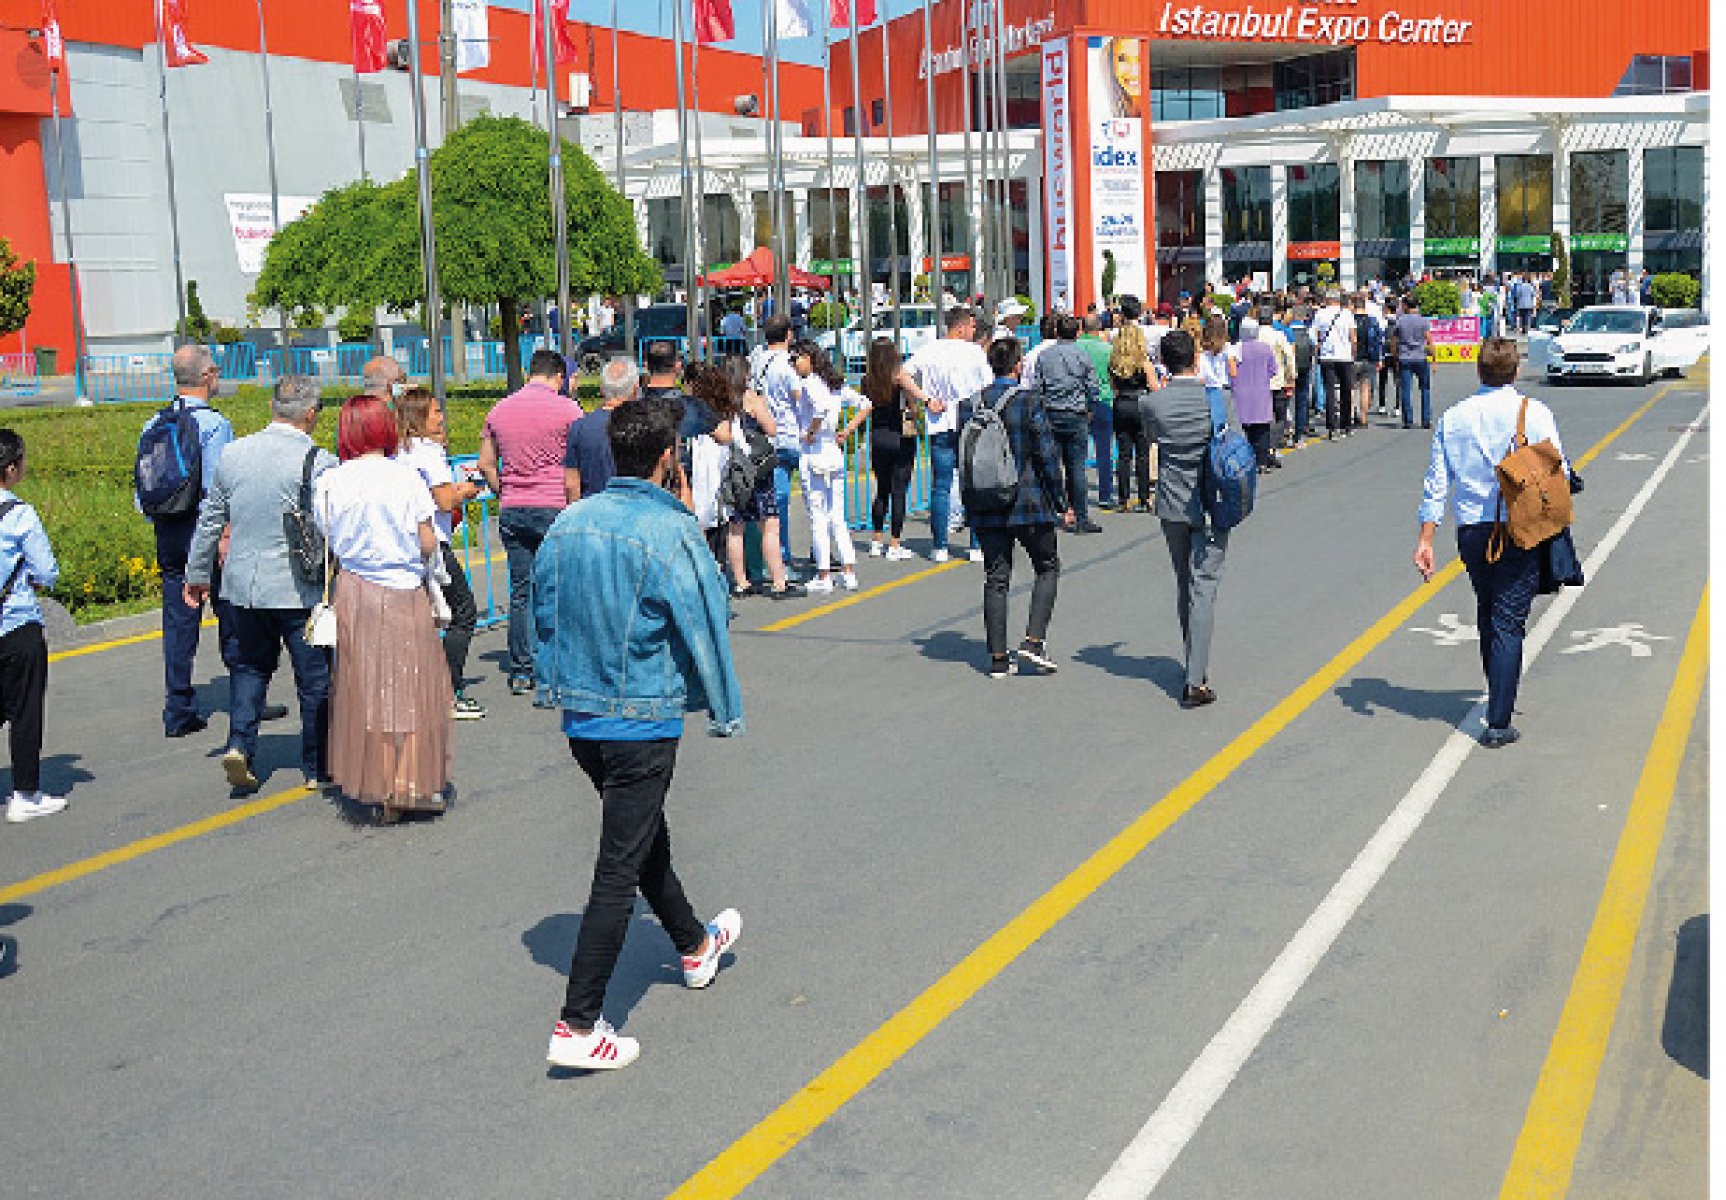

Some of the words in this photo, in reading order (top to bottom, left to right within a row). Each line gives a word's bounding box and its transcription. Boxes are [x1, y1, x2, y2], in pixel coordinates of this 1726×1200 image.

[1157, 3, 1293, 38] Istanbul
[1299, 7, 1370, 45] Expo
[1378, 11, 1473, 44] Center
[1092, 145, 1138, 166] idex
